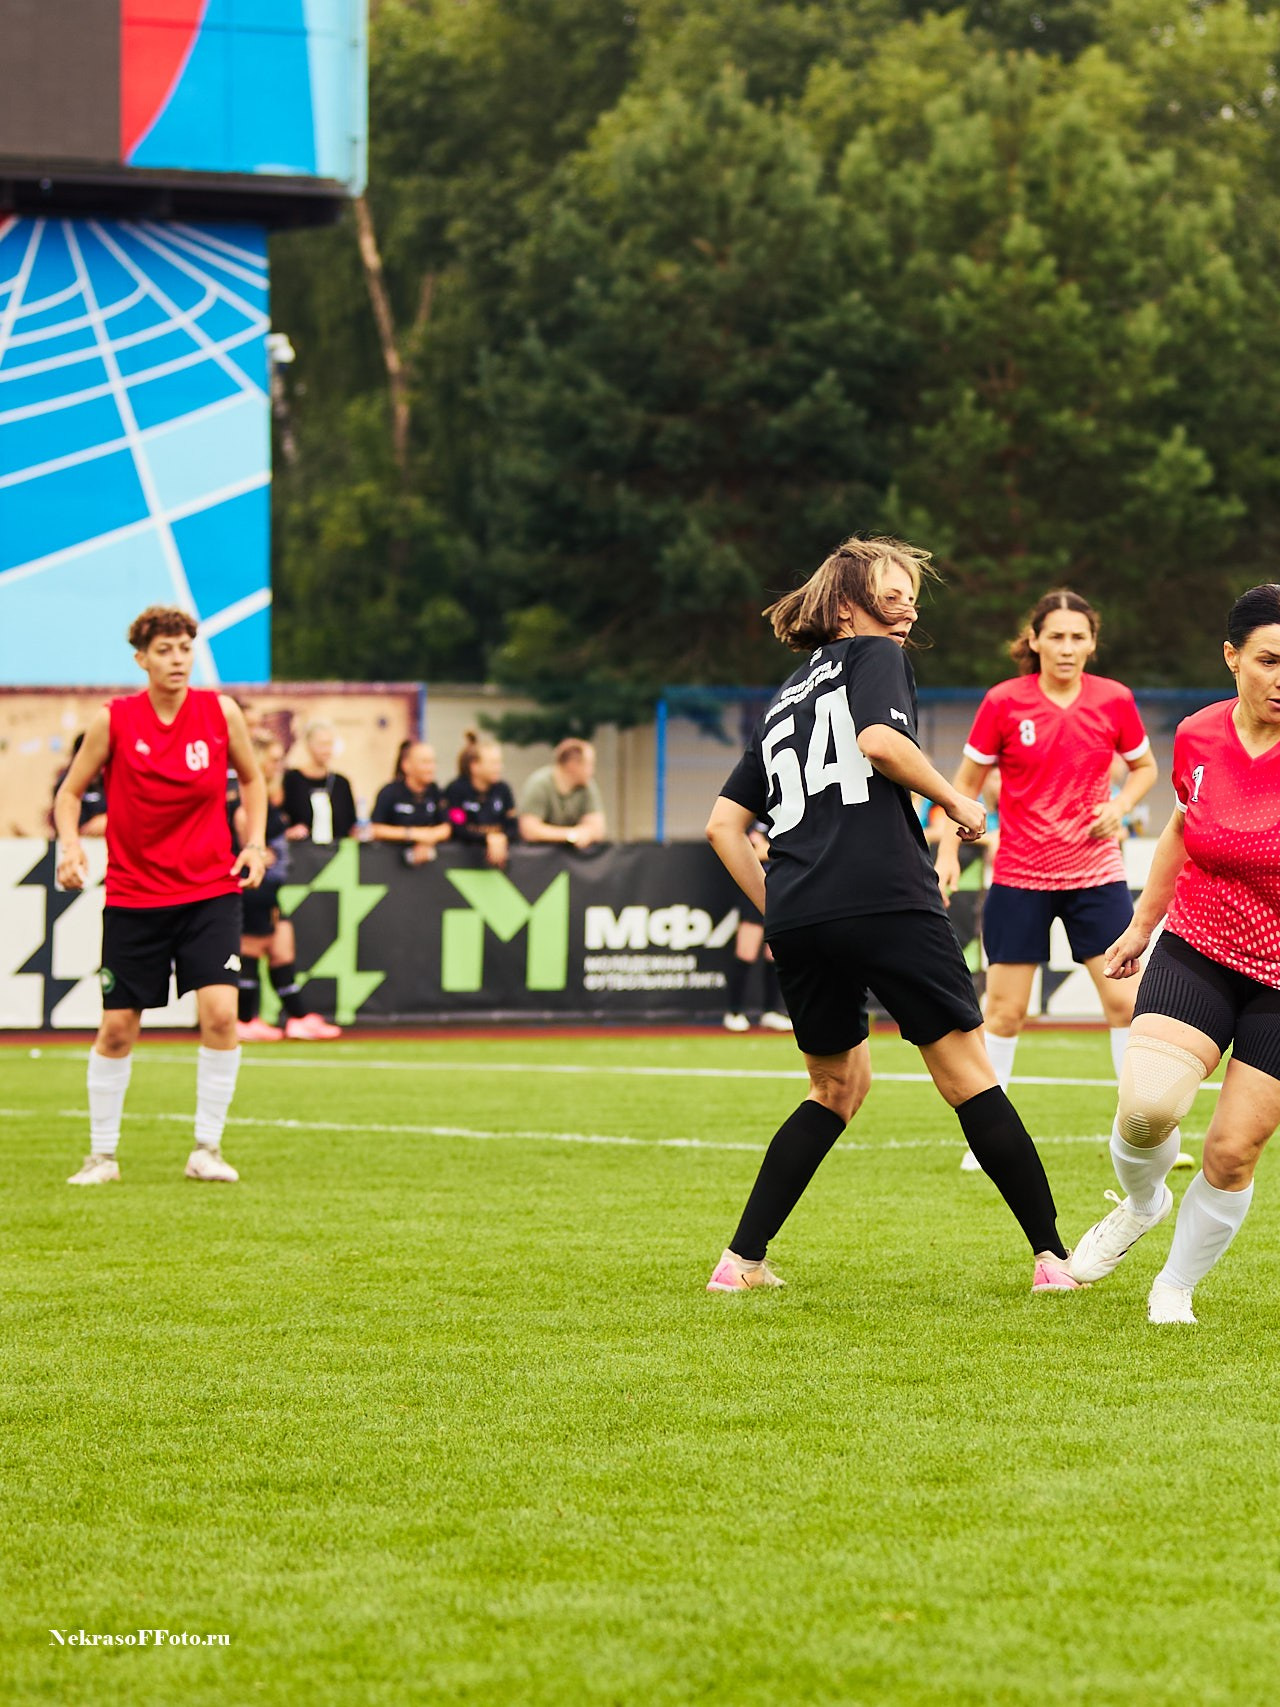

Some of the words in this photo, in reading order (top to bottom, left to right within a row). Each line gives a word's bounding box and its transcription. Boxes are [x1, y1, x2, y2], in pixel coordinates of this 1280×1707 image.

[1018, 719, 1037, 747] 8
[185, 739, 210, 772] 69
[761, 685, 874, 840] 54
[1191, 765, 1204, 803] 1
